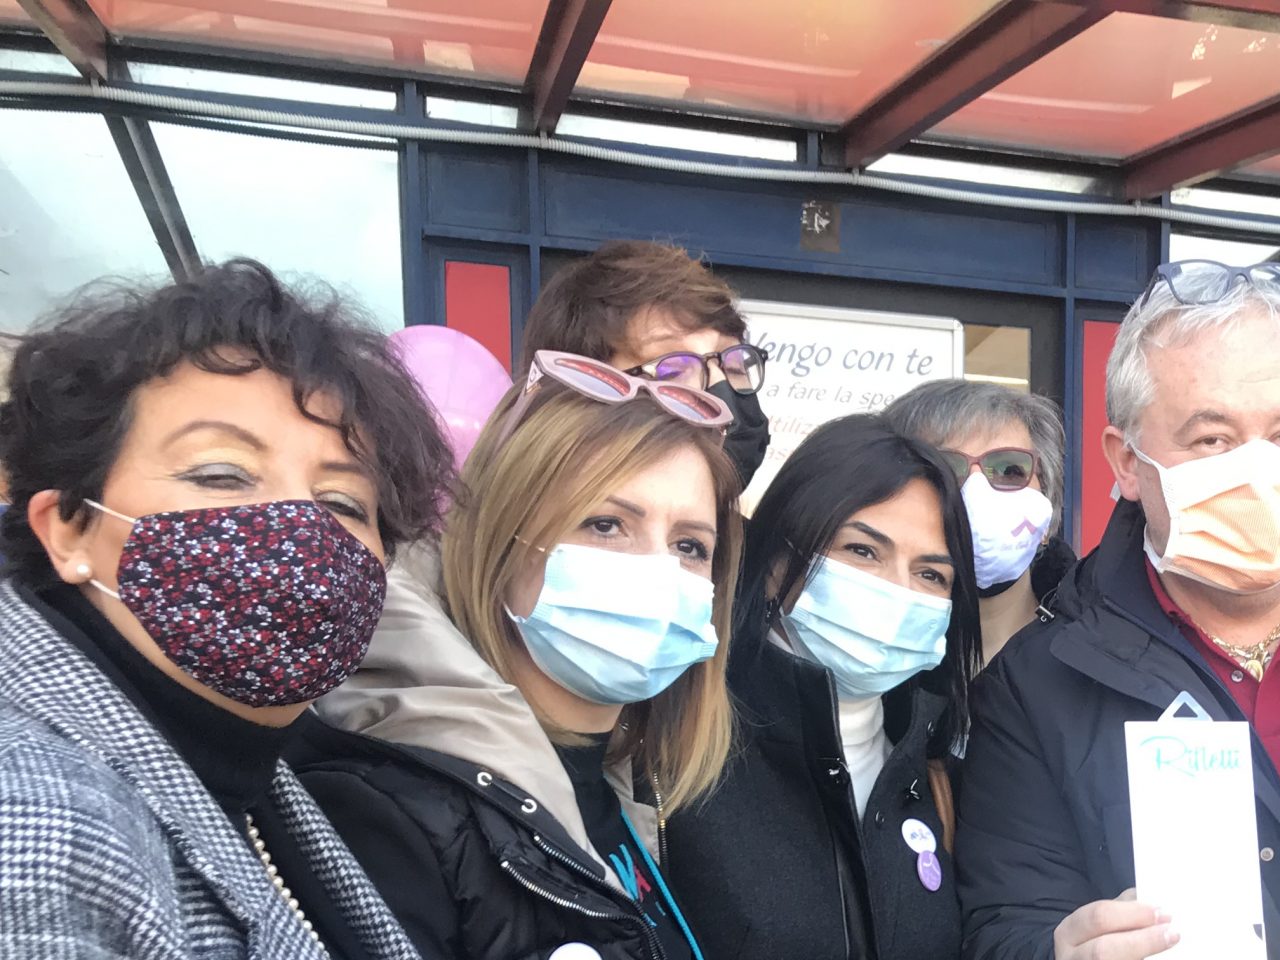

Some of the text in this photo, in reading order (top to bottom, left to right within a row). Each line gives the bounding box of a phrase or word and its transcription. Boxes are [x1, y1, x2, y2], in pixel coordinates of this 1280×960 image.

[842, 348, 895, 372] con
[905, 348, 933, 376] te
[766, 381, 896, 410] a fare la spe
[1139, 735, 1240, 778] Rifletti
